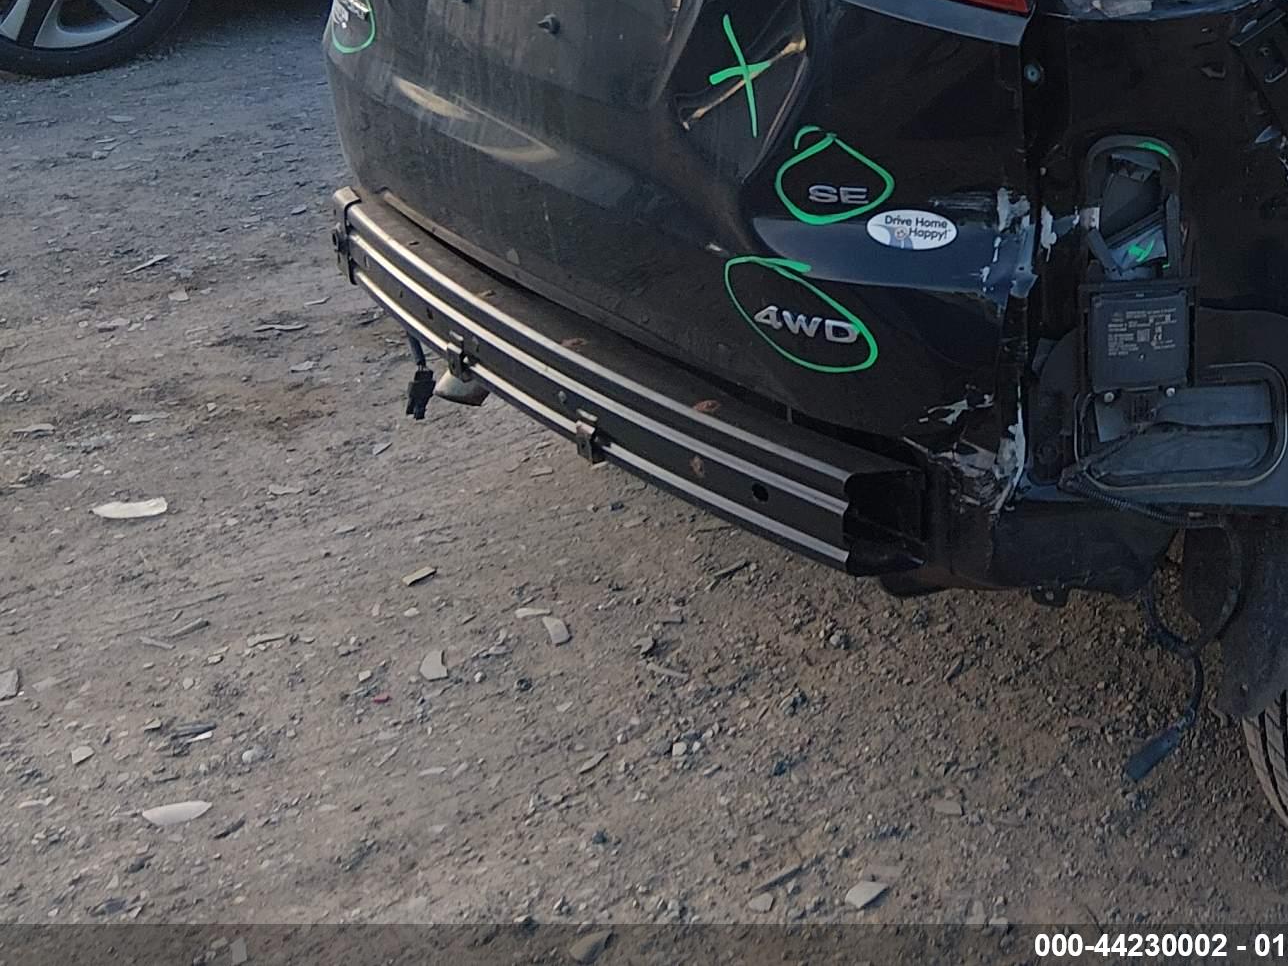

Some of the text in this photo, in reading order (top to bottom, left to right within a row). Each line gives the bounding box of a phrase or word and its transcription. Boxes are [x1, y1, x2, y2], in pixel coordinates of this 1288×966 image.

[808, 185, 869, 204] SE
[884, 215, 948, 229] Drive Home
[908, 227, 948, 241] Happy!
[754, 305, 860, 344] 4WD
